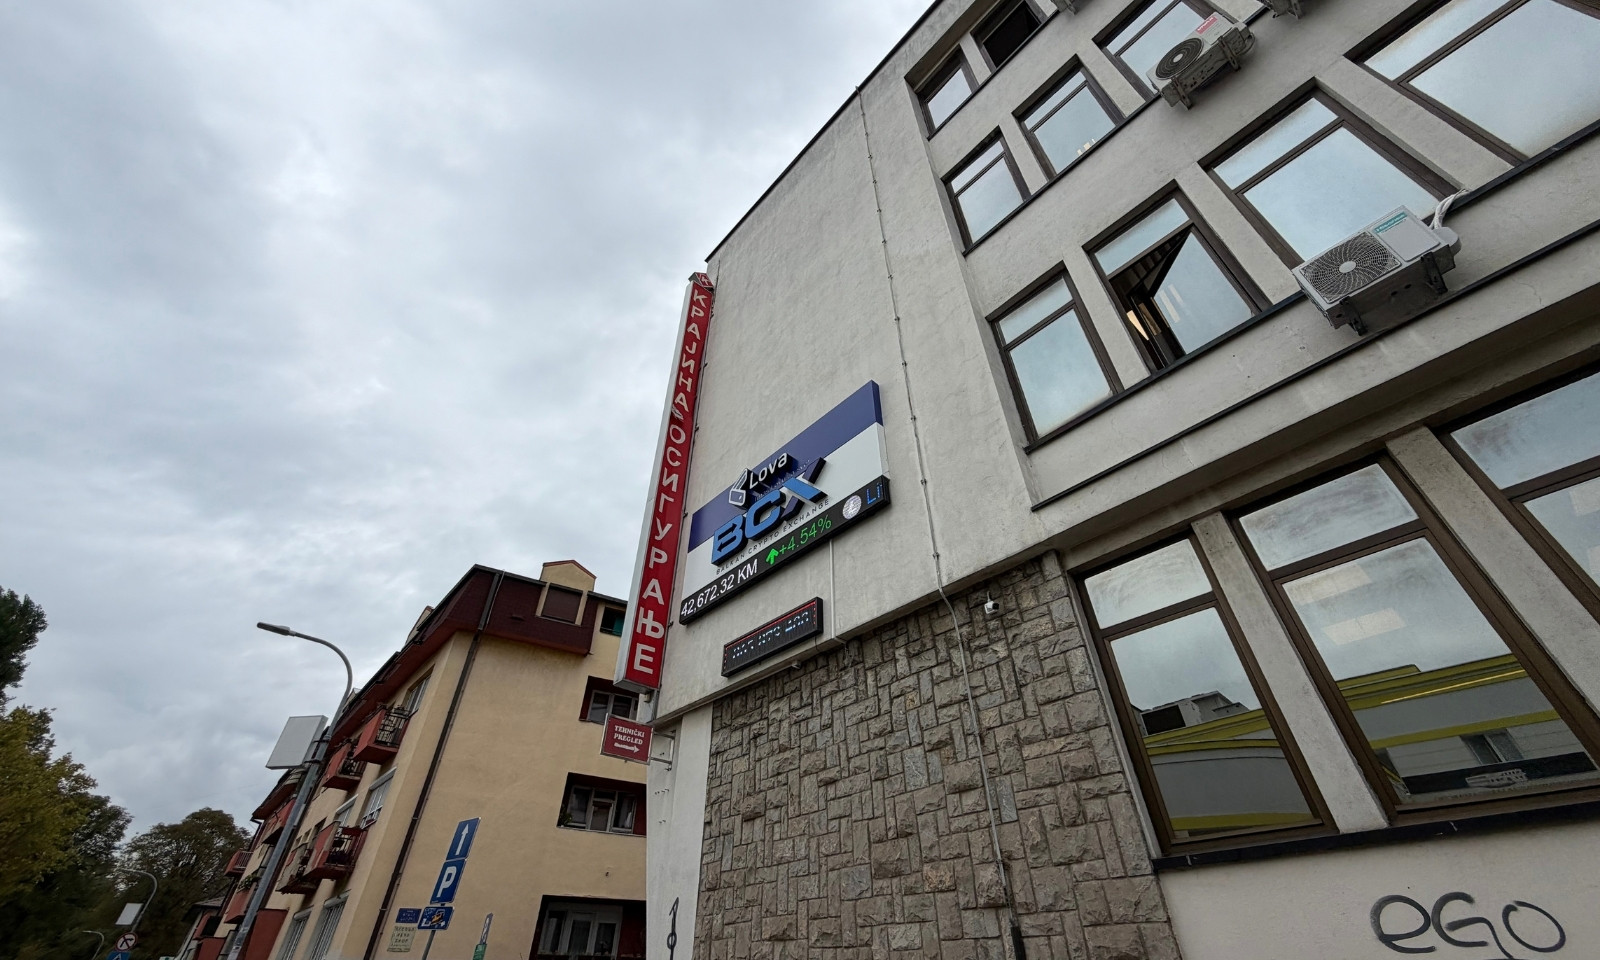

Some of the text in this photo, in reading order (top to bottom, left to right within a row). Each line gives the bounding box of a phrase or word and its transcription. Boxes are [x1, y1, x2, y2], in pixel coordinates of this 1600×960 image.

[633, 288, 708, 674] КРАЈИНА ОСИГУРАЊЕ
[749, 452, 788, 490] Lova
[711, 457, 828, 565] BCX
[716, 498, 830, 575] BALKAN CRYPTO EXCHANGE
[680, 578, 735, 616] 42,672.32
[737, 558, 758, 584] KM
[779, 514, 832, 554] +4.54%
[613, 732, 643, 745] PREGLED
[614, 725, 645, 738] TEHNIČKI
[436, 865, 457, 898] P
